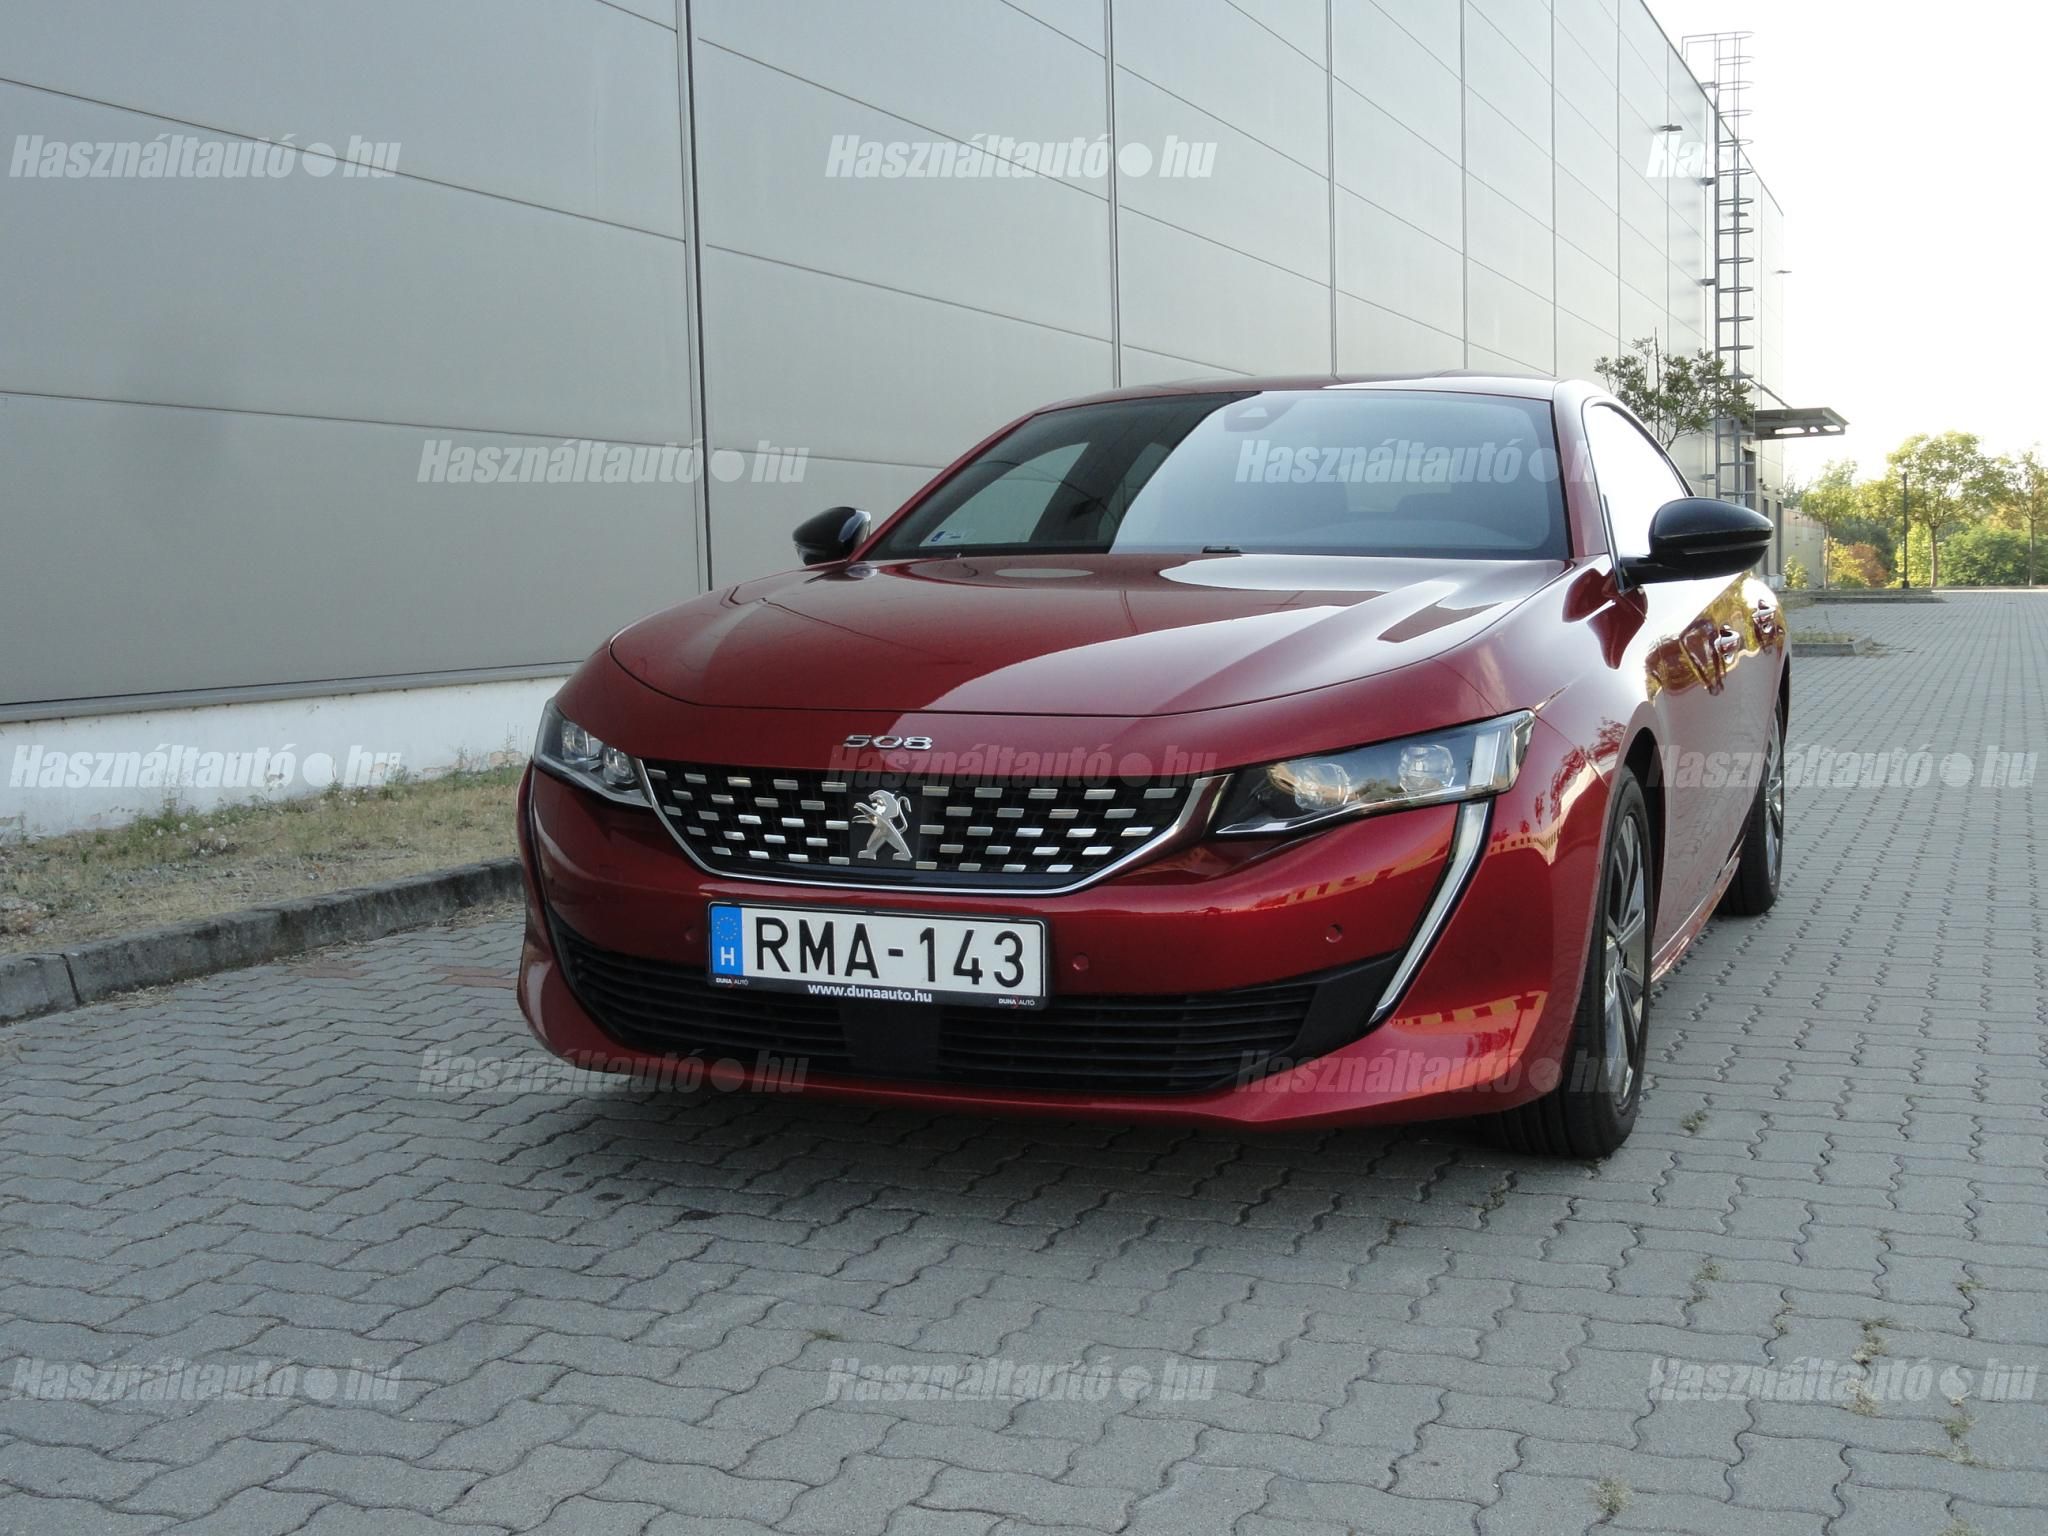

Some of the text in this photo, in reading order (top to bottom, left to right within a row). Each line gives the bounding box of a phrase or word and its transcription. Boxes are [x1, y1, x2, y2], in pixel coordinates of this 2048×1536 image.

[843, 734, 934, 750] 508
[720, 946, 735, 967] H
[755, 916, 1025, 988] RMA-143
[807, 983, 933, 1003] www.dunaauto.hu
